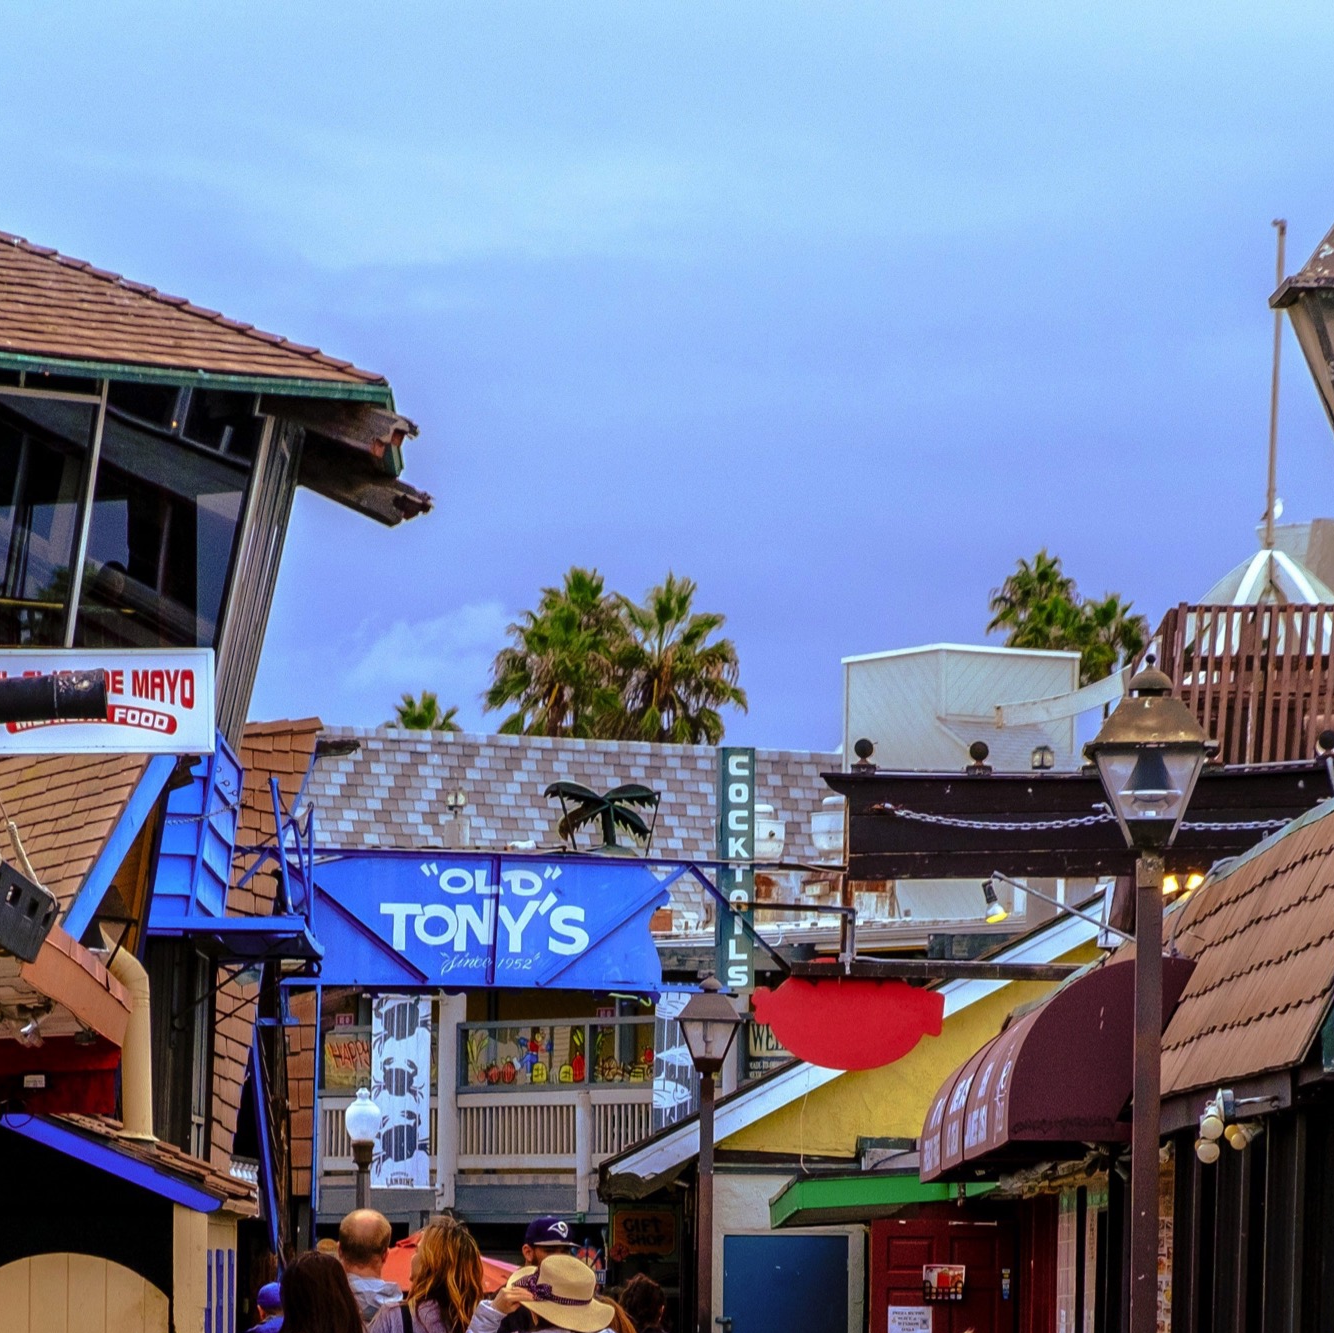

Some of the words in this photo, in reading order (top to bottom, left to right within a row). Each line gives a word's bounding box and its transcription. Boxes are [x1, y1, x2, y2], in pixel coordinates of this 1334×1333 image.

[131, 669, 195, 710] MAYO
[114, 708, 169, 730] FOOD
[727, 754, 750, 988] COCKTAILS
[380, 891, 590, 956] TONY'S
[329, 1038, 371, 1069] HAPPY
[622, 1216, 663, 1233] GIFT
[626, 1233, 666, 1246] SHOP
